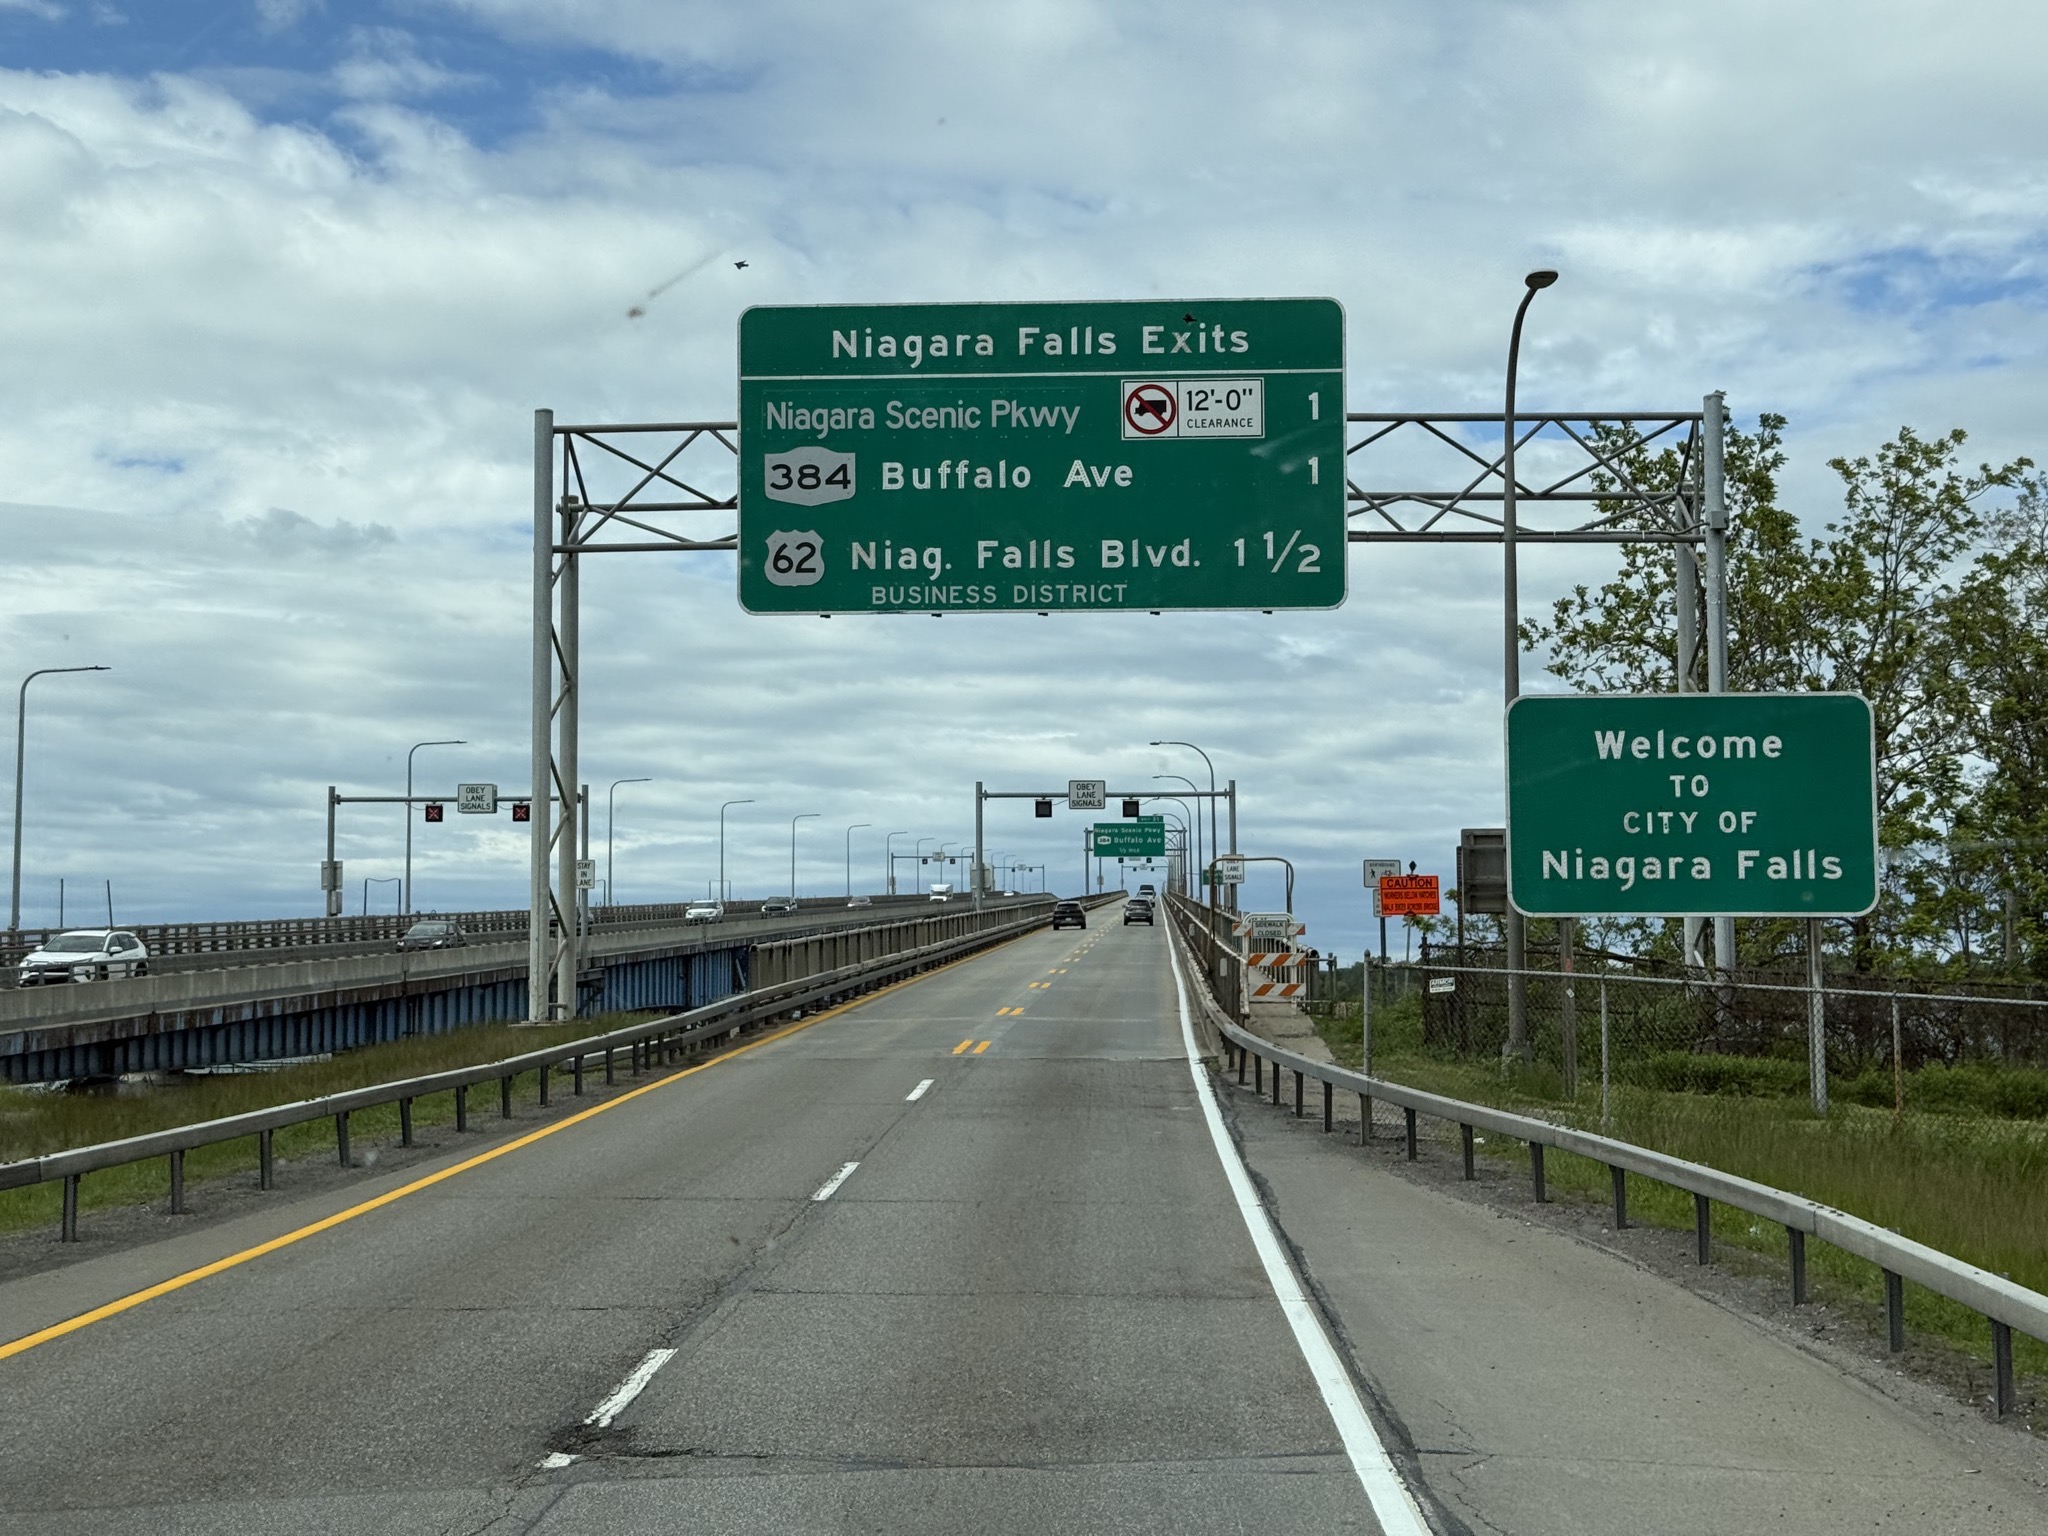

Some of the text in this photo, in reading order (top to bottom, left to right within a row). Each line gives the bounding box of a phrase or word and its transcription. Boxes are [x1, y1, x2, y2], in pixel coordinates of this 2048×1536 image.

[832, 324, 1249, 368] Niagara Falls Exits
[1186, 388, 1254, 412] 12'-0"
[1308, 391, 1319, 421] 1
[766, 399, 1081, 438] Niagara Scenic Pkwy
[1186, 417, 1254, 429] CLEARANCE
[770, 463, 852, 491] 384
[881, 459, 1133, 489] Buffalo Ave
[1308, 456, 1319, 485] 1
[772, 543, 817, 574] 62
[851, 539, 952, 580] Niag.
[977, 539, 1075, 569] Falls
[1101, 538, 1201, 569] Blvd.
[1234, 538, 1245, 567] 1
[872, 584, 1128, 605] BUSINESS DISTRICT
[1594, 728, 1783, 760] Welcome
[465, 786, 486, 794] OBEY
[1075, 783, 1096, 791] OBEY
[1076, 791, 1097, 799] LANE
[1669, 774, 1709, 798] TO
[460, 802, 491, 811] SIGNALS
[465, 794, 485, 802] LANE
[1071, 798, 1103, 807] SIGNALS
[1144, 826, 1161, 834] Pkwy
[1623, 811, 1757, 834] CITY OF
[1146, 836, 1162, 844] Ave
[577, 862, 591, 870] STAY
[1542, 848, 1843, 892] Niagara Falls
[1386, 878, 1433, 888] CAUTION
